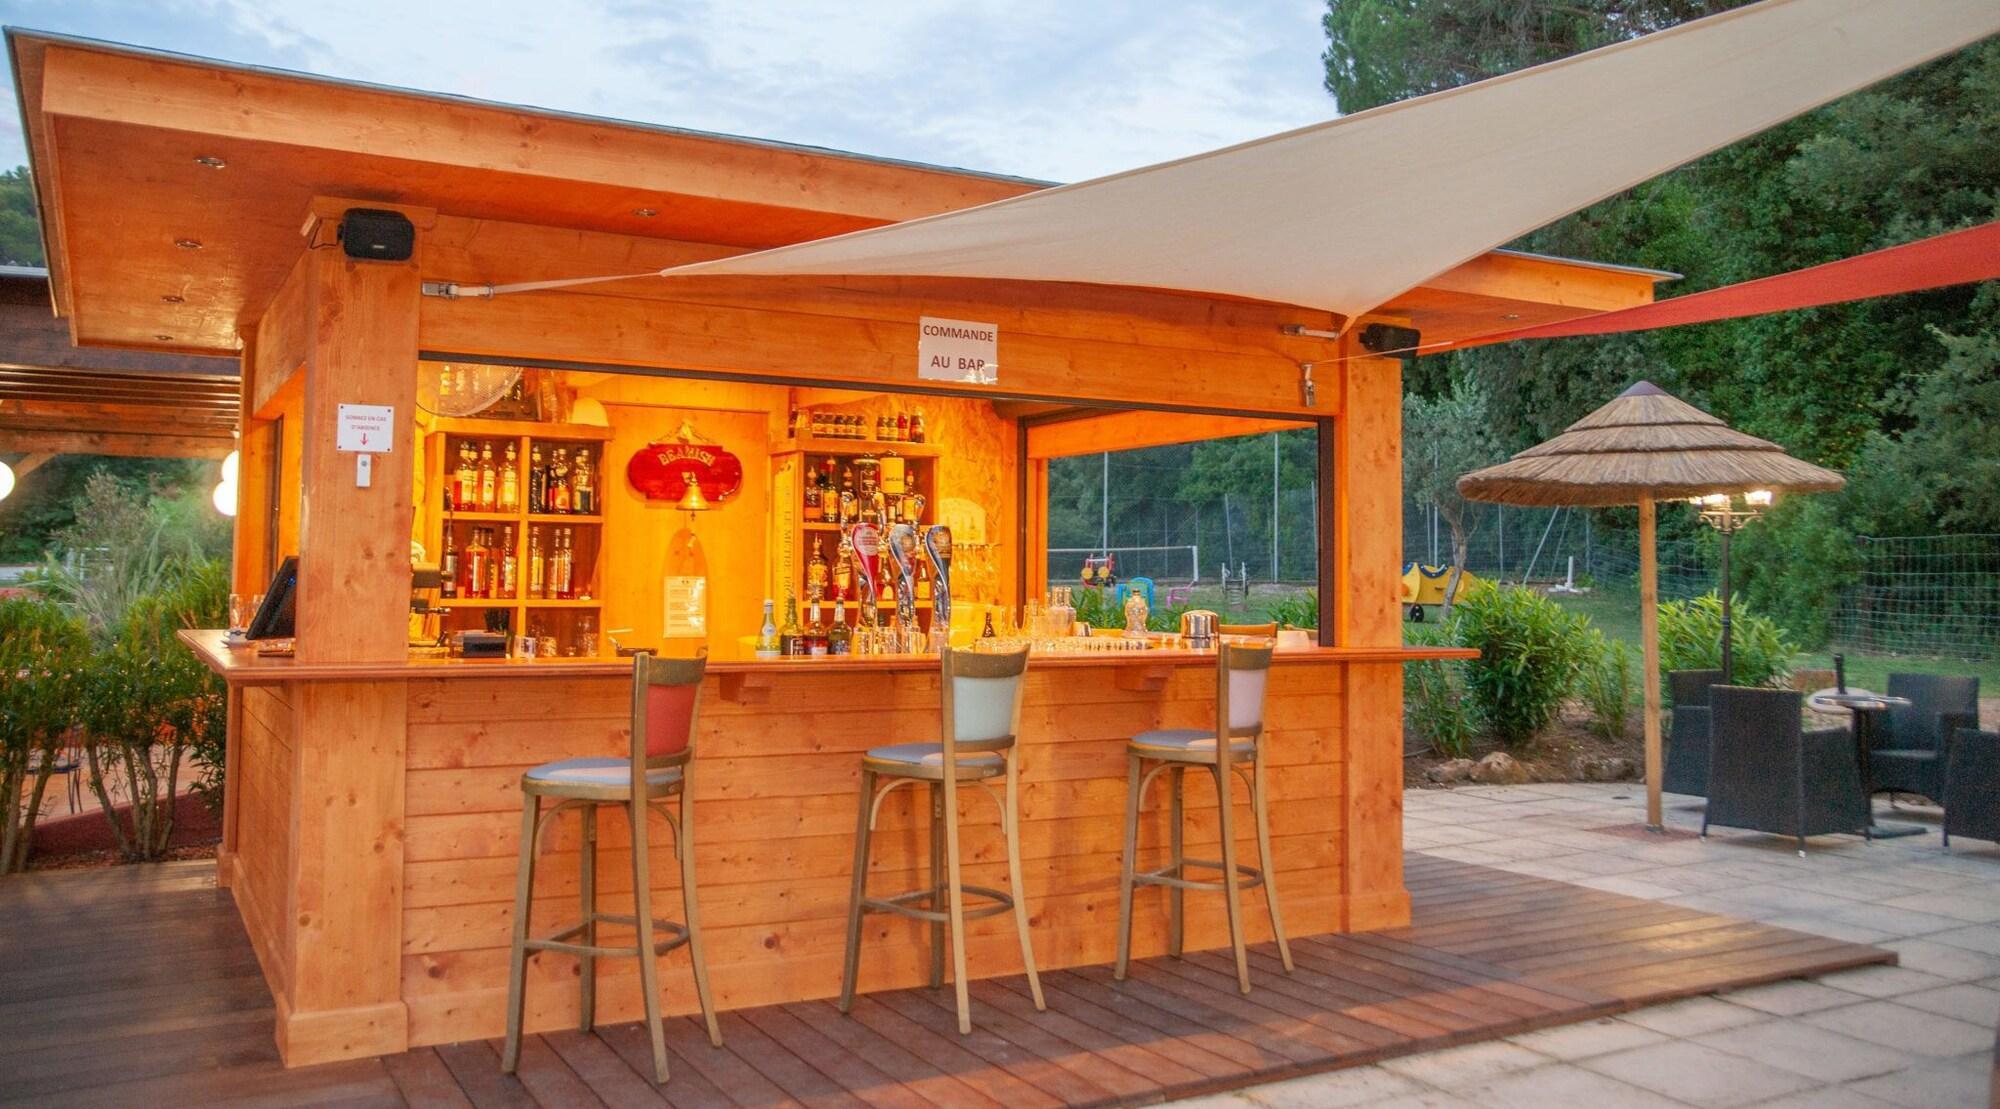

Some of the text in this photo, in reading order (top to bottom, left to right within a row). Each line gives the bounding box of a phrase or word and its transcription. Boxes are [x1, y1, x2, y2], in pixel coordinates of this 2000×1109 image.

[923, 325, 993, 342] COMMANDE
[931, 355, 985, 371] AU BAR
[657, 445, 716, 466] BEAMISH
